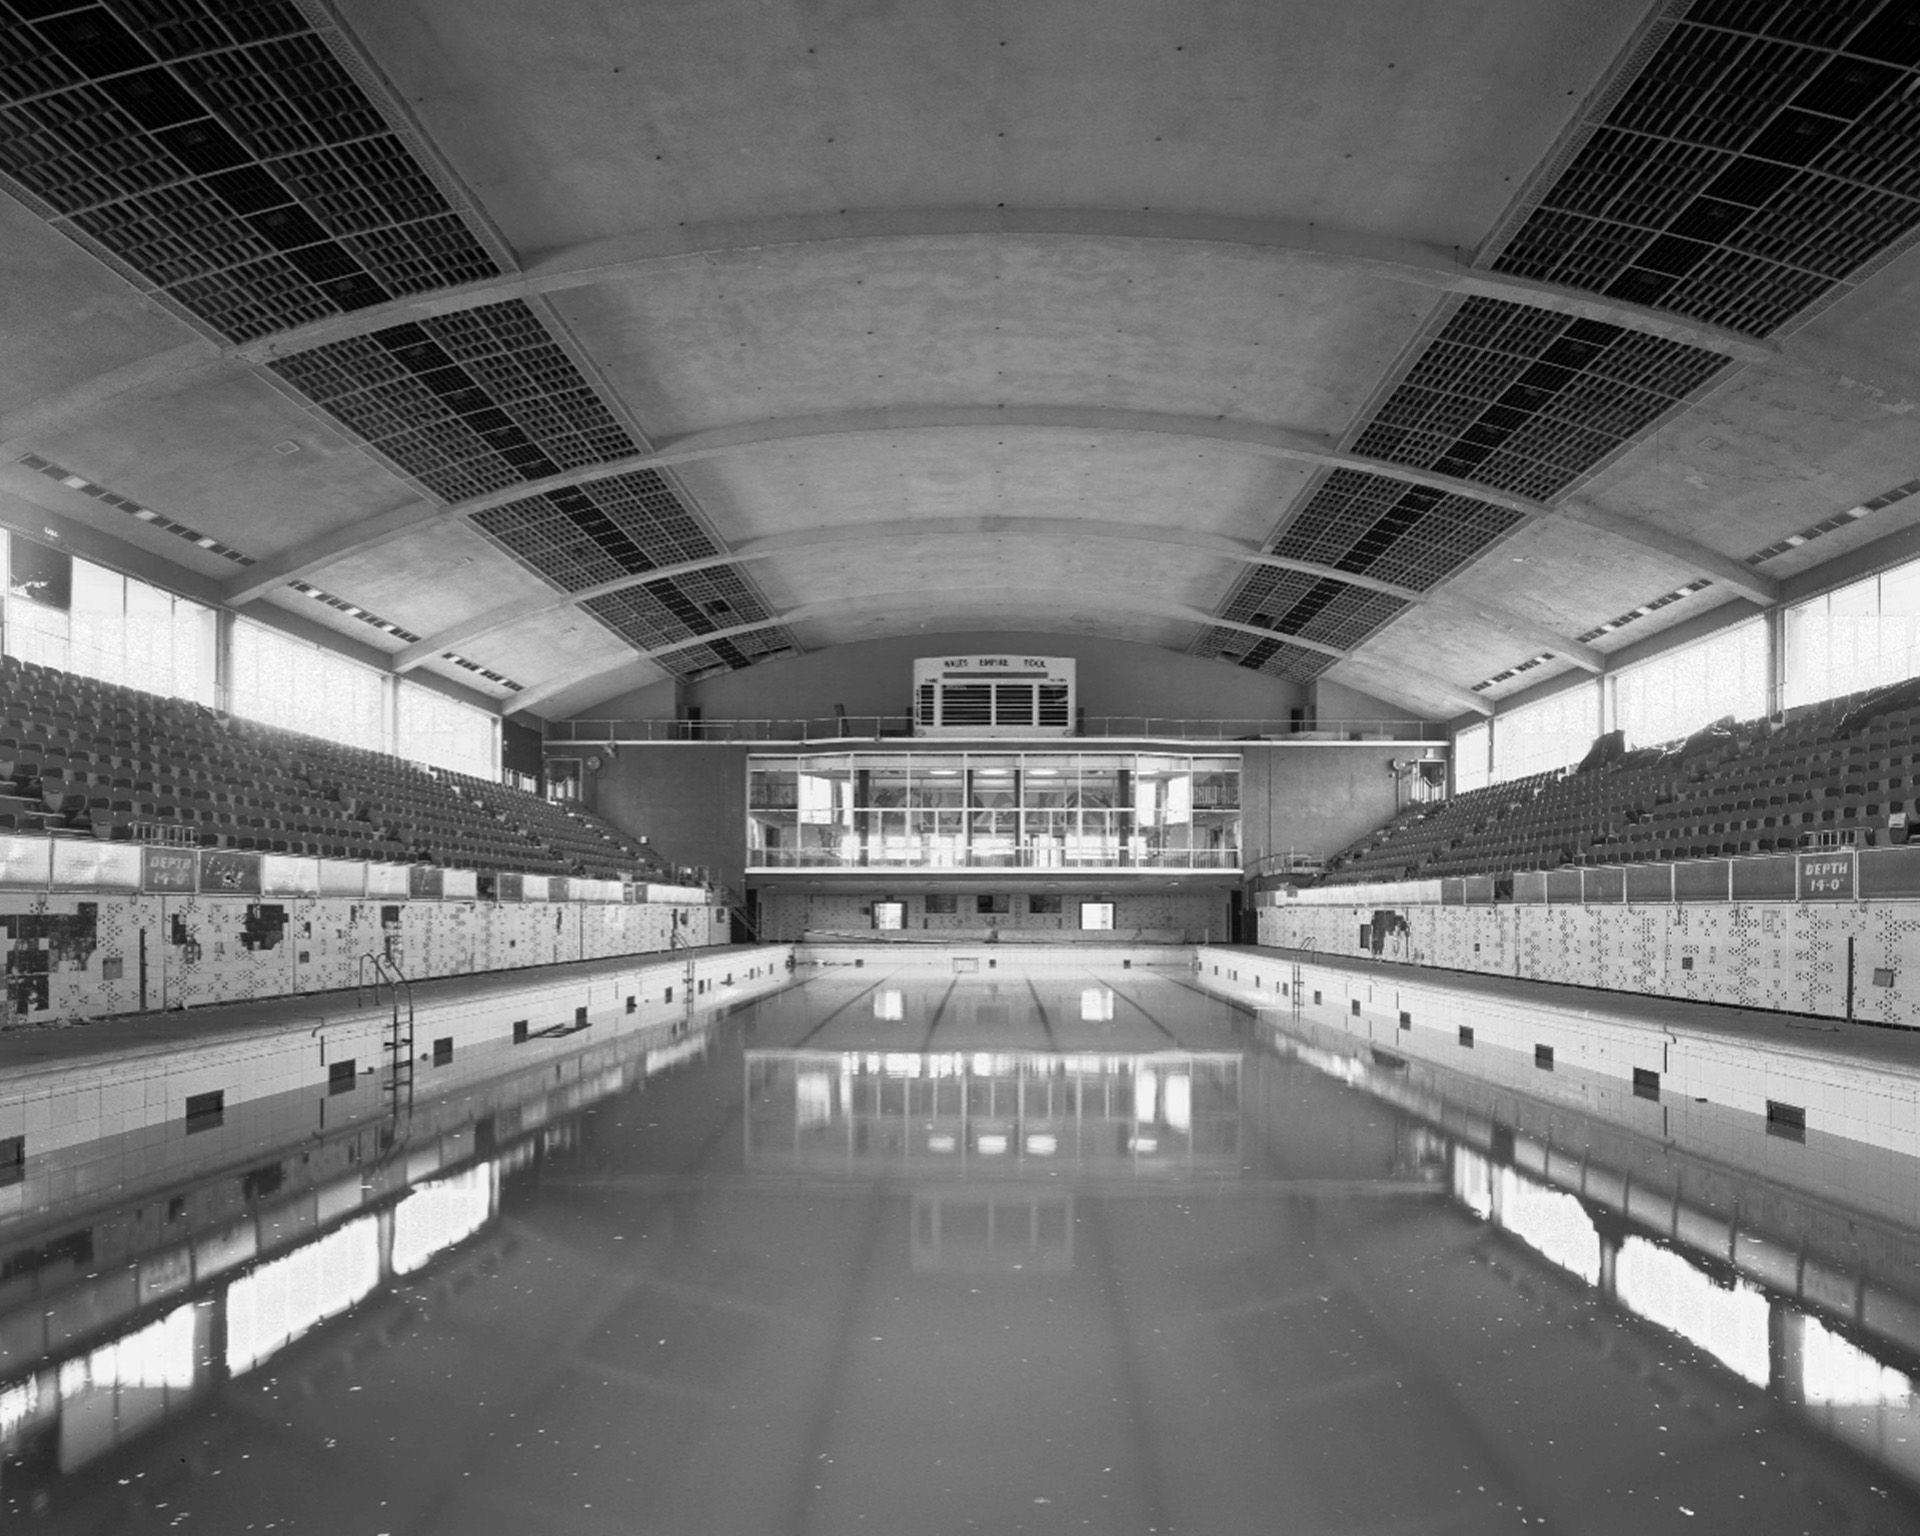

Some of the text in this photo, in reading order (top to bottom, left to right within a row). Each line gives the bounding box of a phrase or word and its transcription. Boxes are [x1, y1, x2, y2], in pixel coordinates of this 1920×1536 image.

[979, 658, 1008, 667] EMPIRE
[150, 856, 191, 869] DEPTH
[1804, 862, 1848, 876] DEPTH
